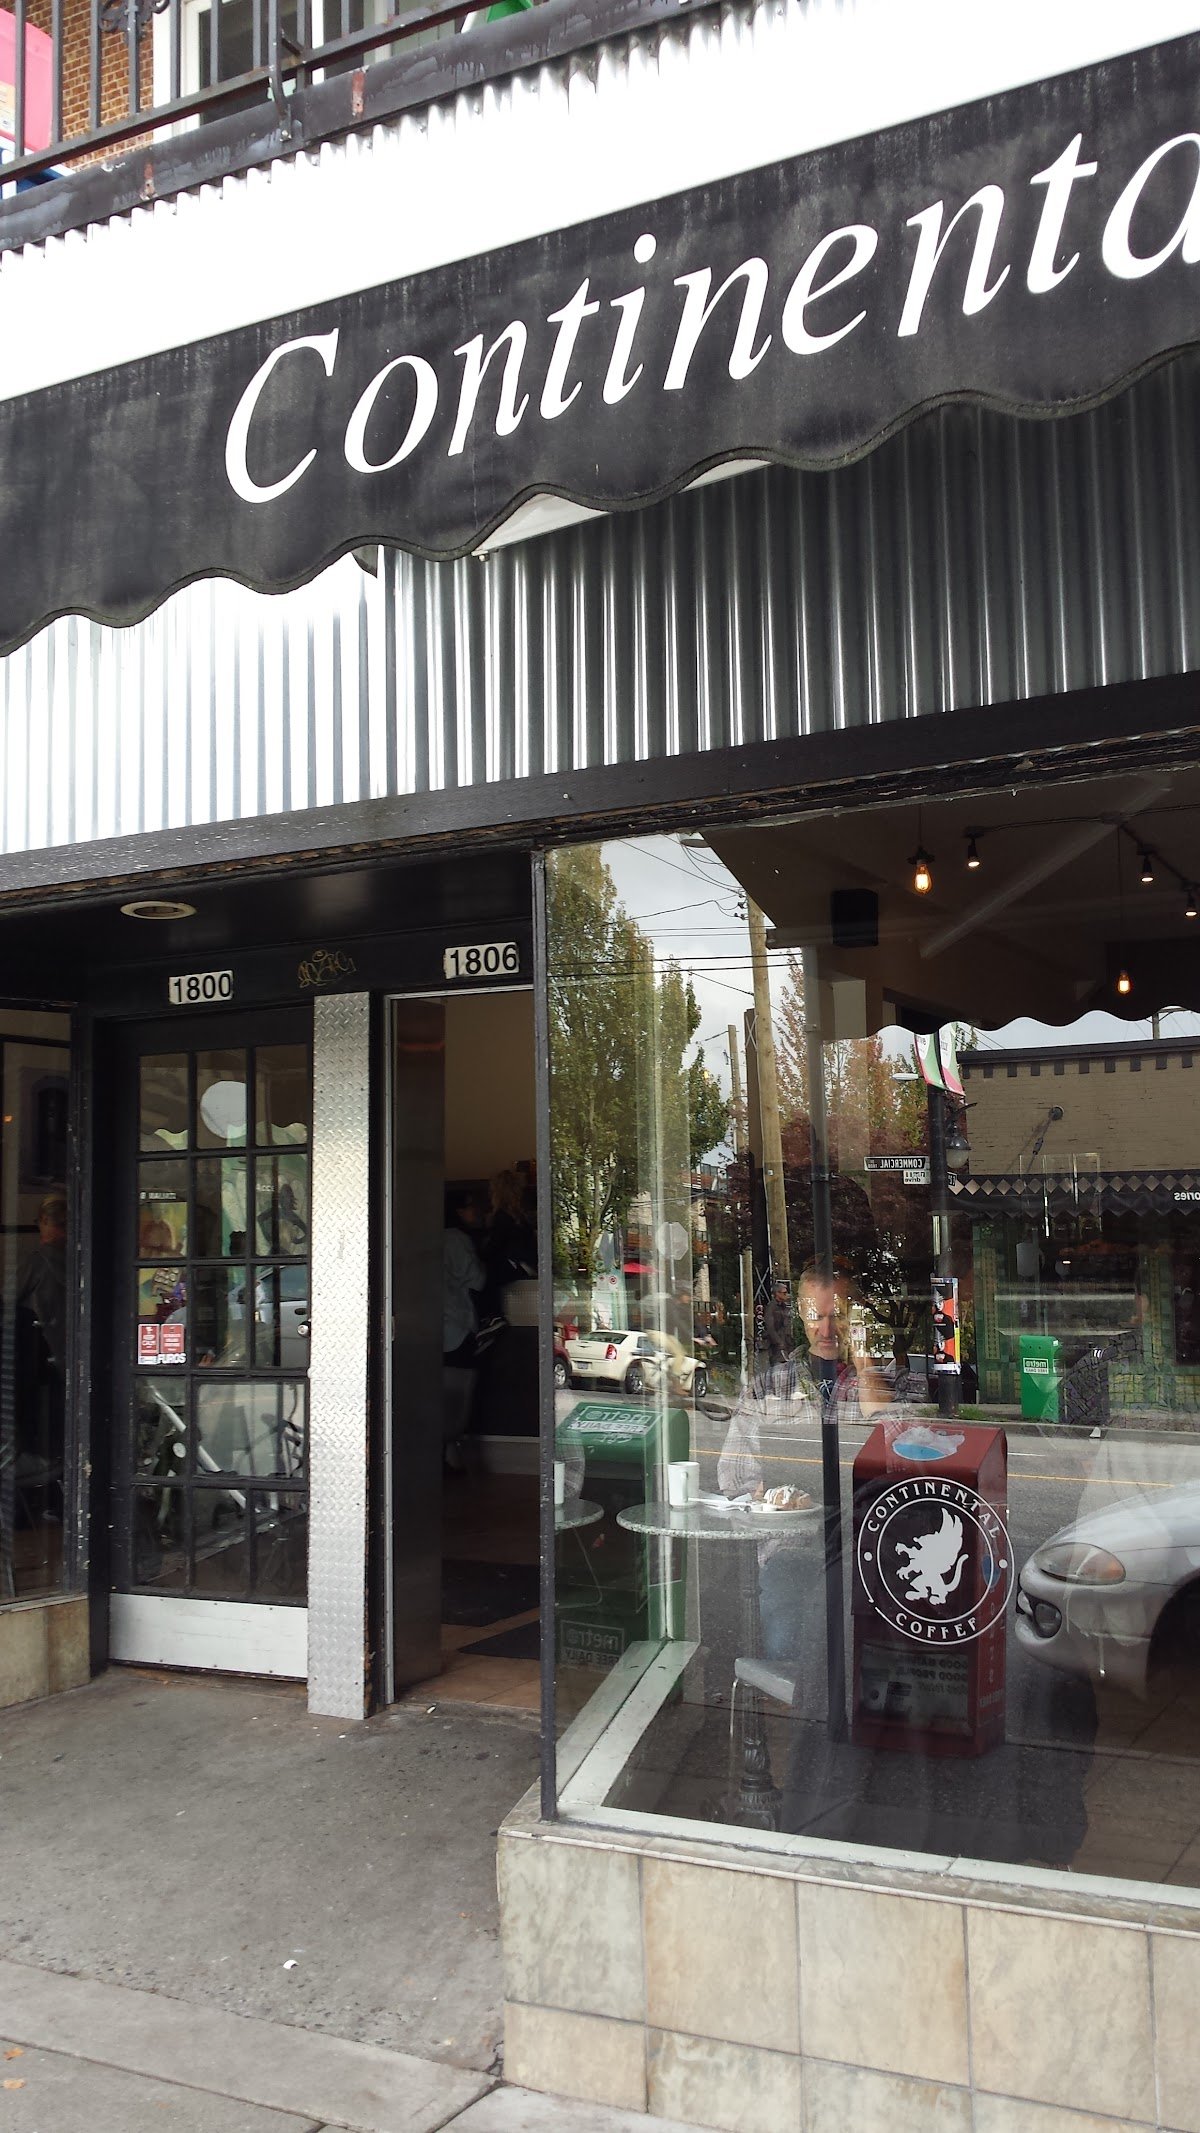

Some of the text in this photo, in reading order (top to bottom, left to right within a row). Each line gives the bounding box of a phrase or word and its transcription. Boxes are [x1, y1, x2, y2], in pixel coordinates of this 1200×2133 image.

[450, 943, 518, 975] 1806
[173, 973, 231, 1000] 1800
[867, 1481, 1000, 1539] CONTINENTAL
